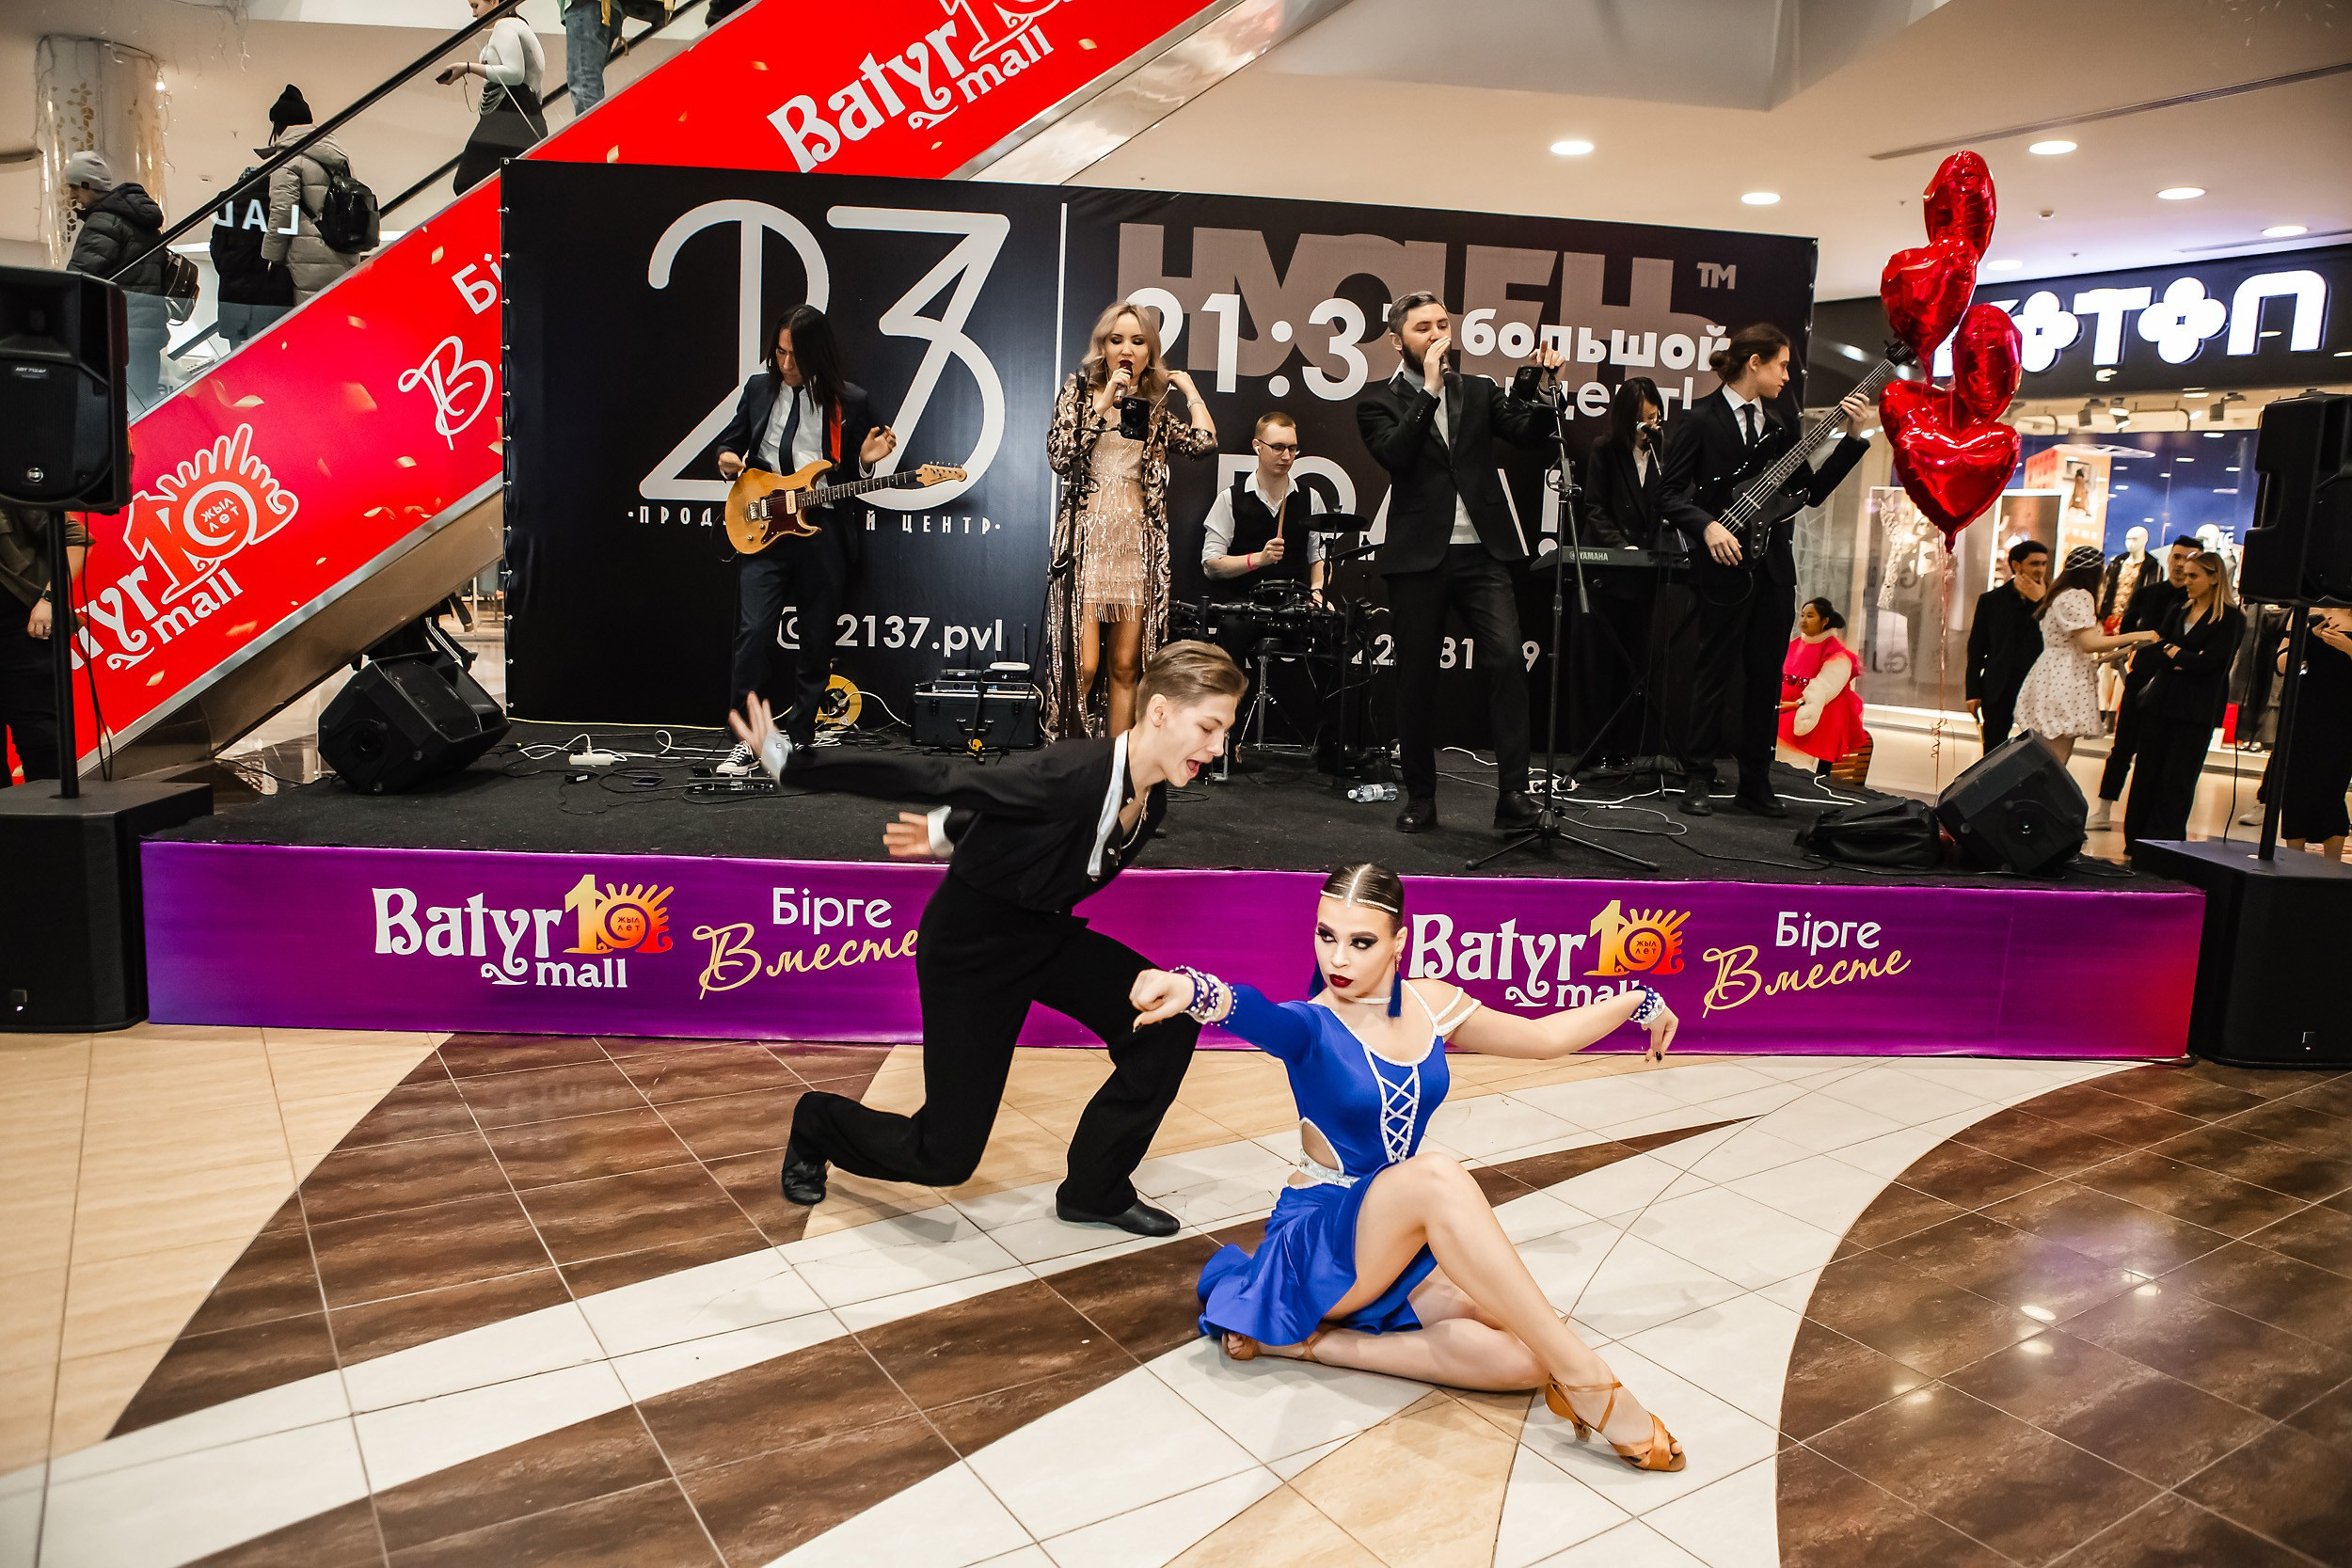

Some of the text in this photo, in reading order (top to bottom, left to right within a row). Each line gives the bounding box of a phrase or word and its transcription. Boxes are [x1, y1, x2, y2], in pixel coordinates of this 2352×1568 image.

[767, 20, 964, 173] Batyr
[956, 24, 1054, 103] mall
[1580, 551, 1609, 562] YAMAHA
[150, 567, 244, 644] mall
[835, 613, 1003, 657] 2137.pvl
[372, 887, 562, 986] Batyr
[771, 887, 893, 936] Бірге
[1774, 911, 1881, 958] Бірге
[534, 956, 628, 989] mall
[691, 922, 919, 1001] Вместе
[1407, 913, 1587, 1007] Batyr
[1702, 943, 1911, 1019] Вместе
